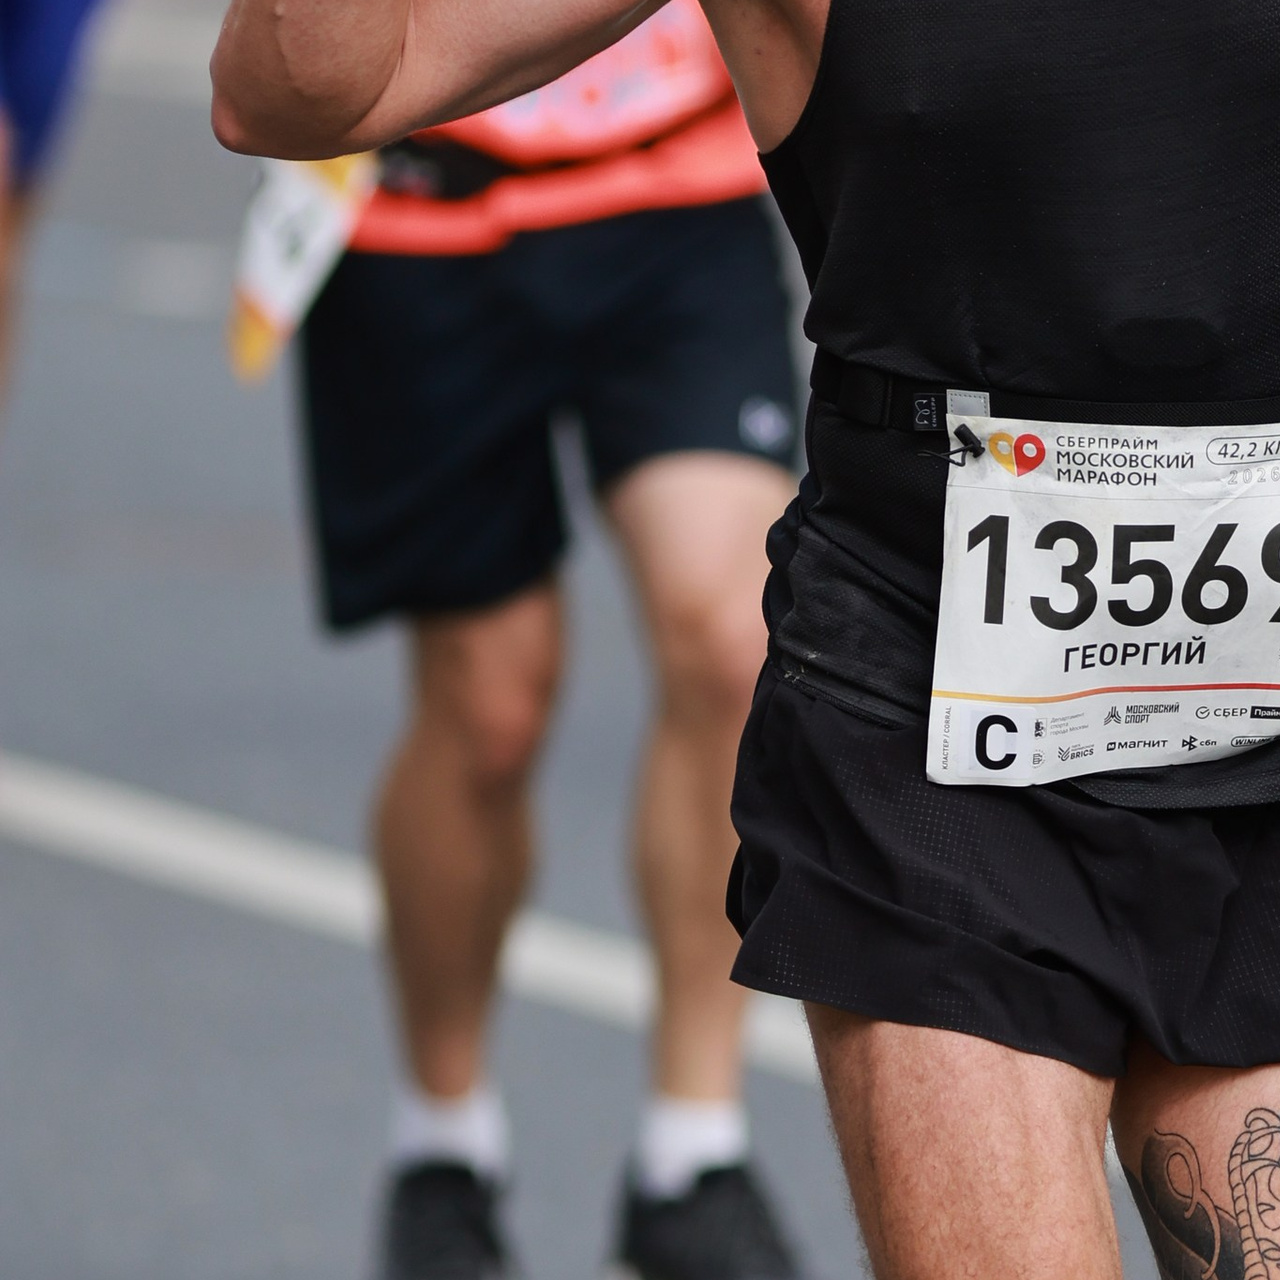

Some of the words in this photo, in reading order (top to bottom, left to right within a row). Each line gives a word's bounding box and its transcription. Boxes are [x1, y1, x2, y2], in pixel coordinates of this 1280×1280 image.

[1056, 436, 1158, 450] СБЕРПРАЙМ
[1218, 442, 1258, 461] 42,2
[1056, 451, 1194, 469] МОСКОВСКИЙ
[1056, 468, 1157, 486] МАРАФОН
[1227, 466, 1280, 485] 2026
[1063, 635, 1206, 673] ГЕОРГИЙ
[1125, 701, 1180, 714] МОСКОВСКИЙ
[1213, 707, 1248, 718] СБЕР
[1124, 714, 1150, 724] СПОРТ
[975, 714, 1019, 771] C
[1070, 748, 1094, 760] BRICS
